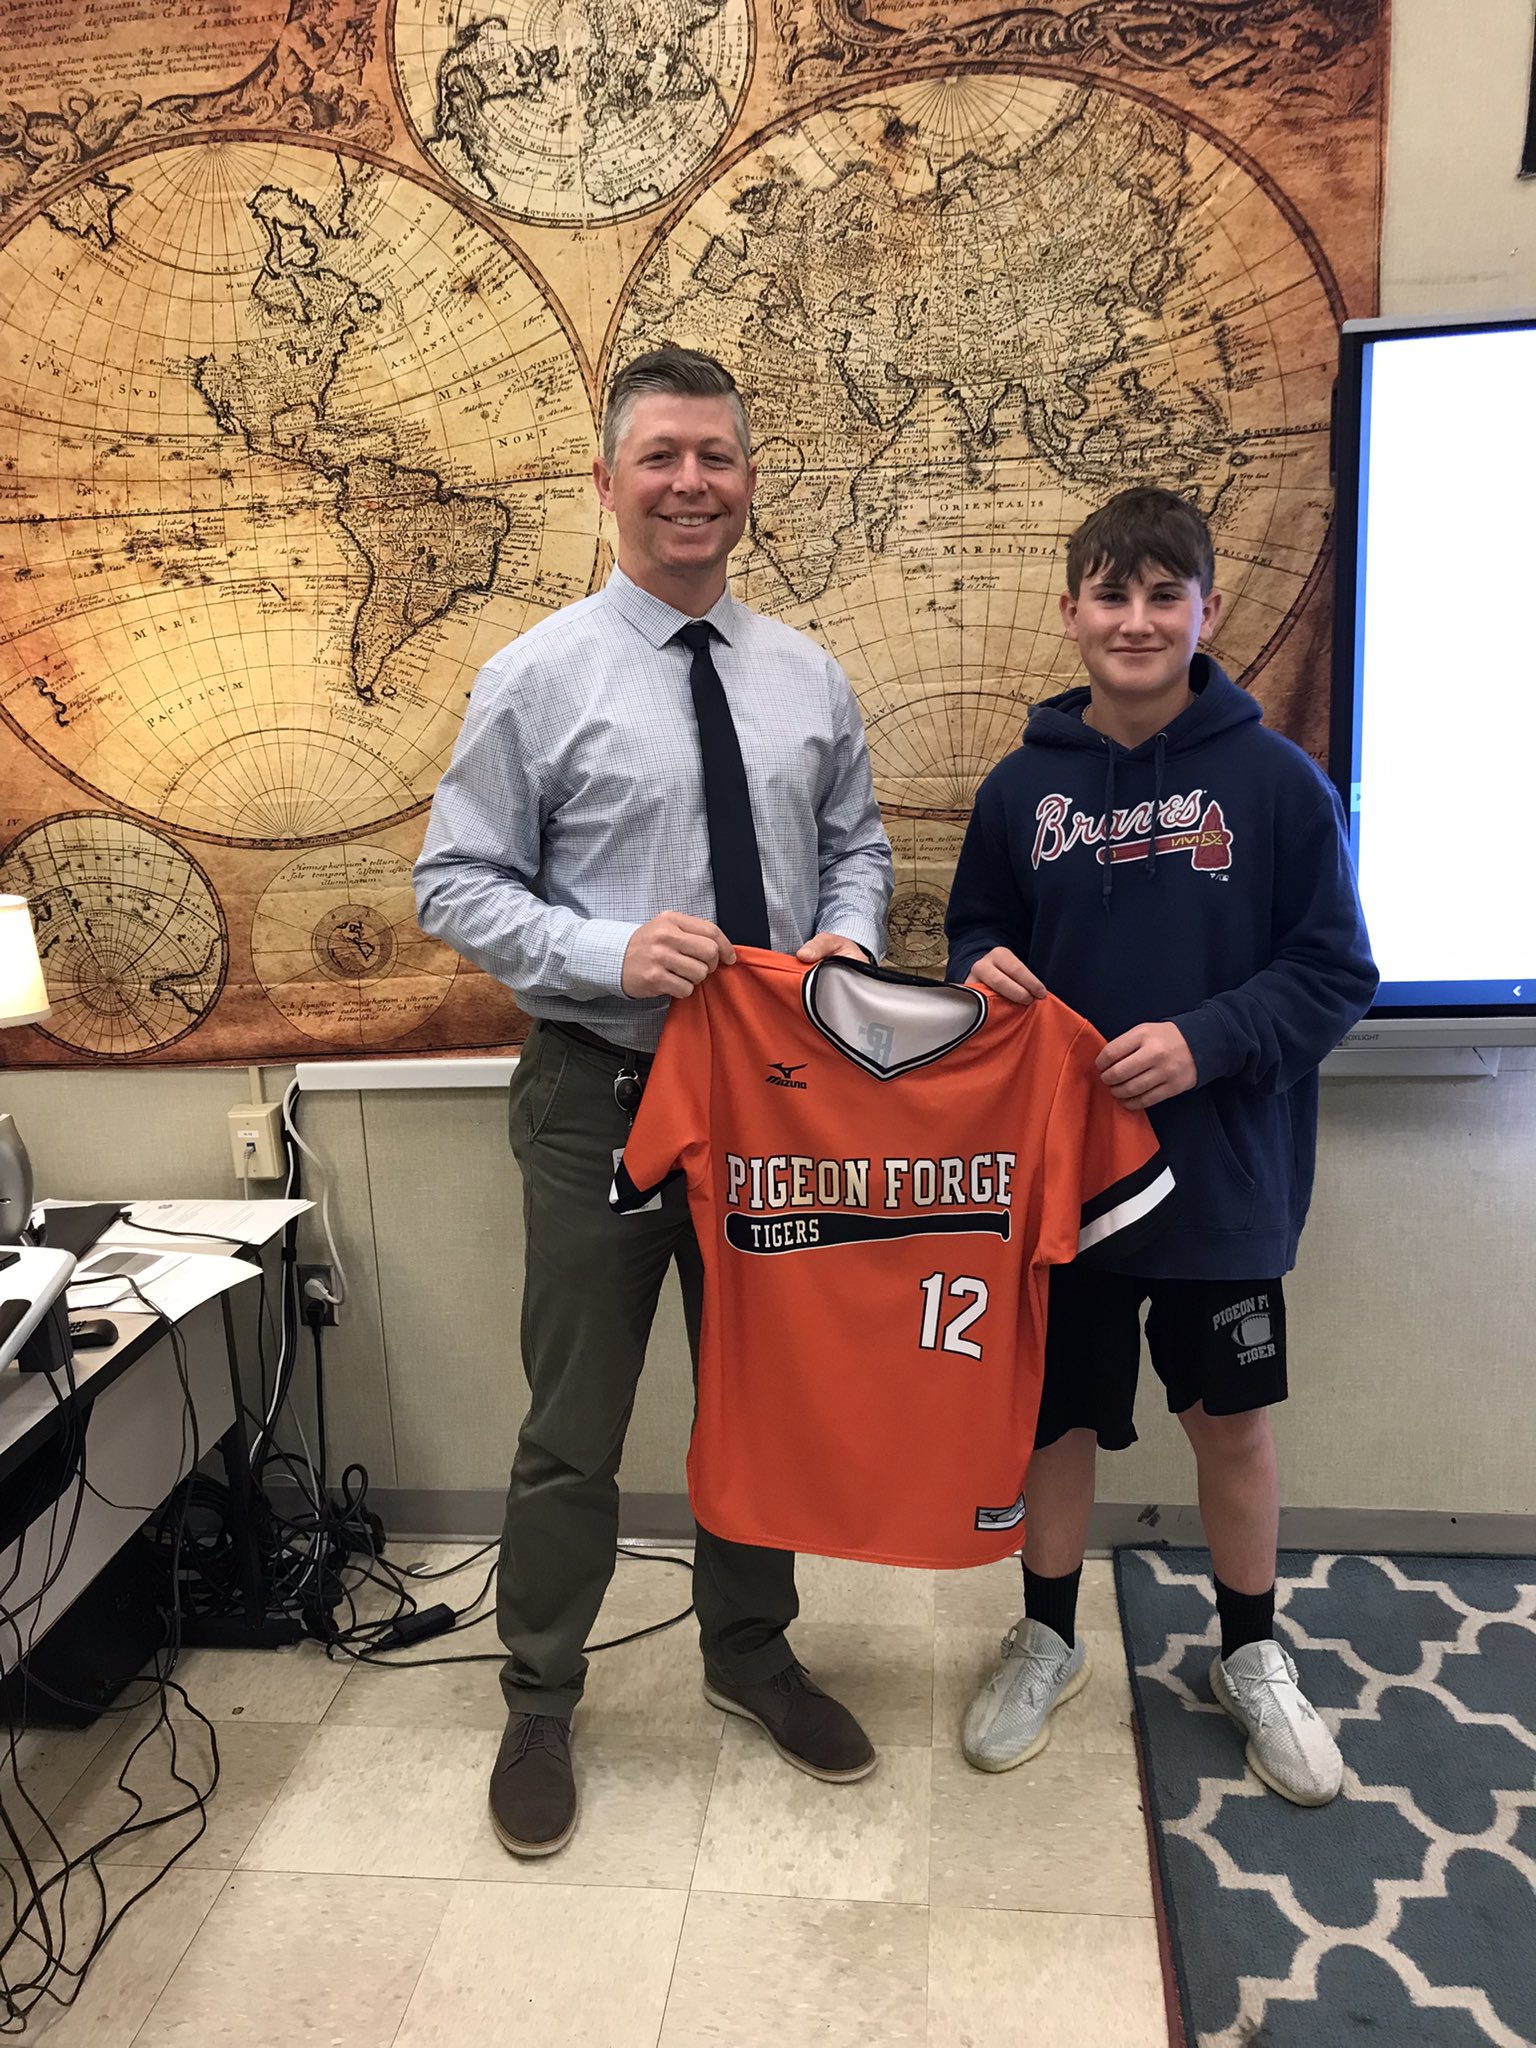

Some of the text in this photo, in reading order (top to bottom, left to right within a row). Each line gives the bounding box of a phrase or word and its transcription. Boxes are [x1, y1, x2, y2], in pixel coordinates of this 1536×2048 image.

[942, 545, 985, 555] MAR
[1007, 543, 1059, 556] INDIA
[133, 615, 200, 643] MARE
[146, 680, 245, 728] PACIFICVM
[1031, 789, 1204, 871] Braves
[726, 1152, 1017, 1210] PIGEON FORGE
[751, 1218, 820, 1248] TIGERS
[919, 1271, 990, 1362] 12
[1212, 1297, 1256, 1331] PIGEON
[1237, 1343, 1277, 1366] TIGER
